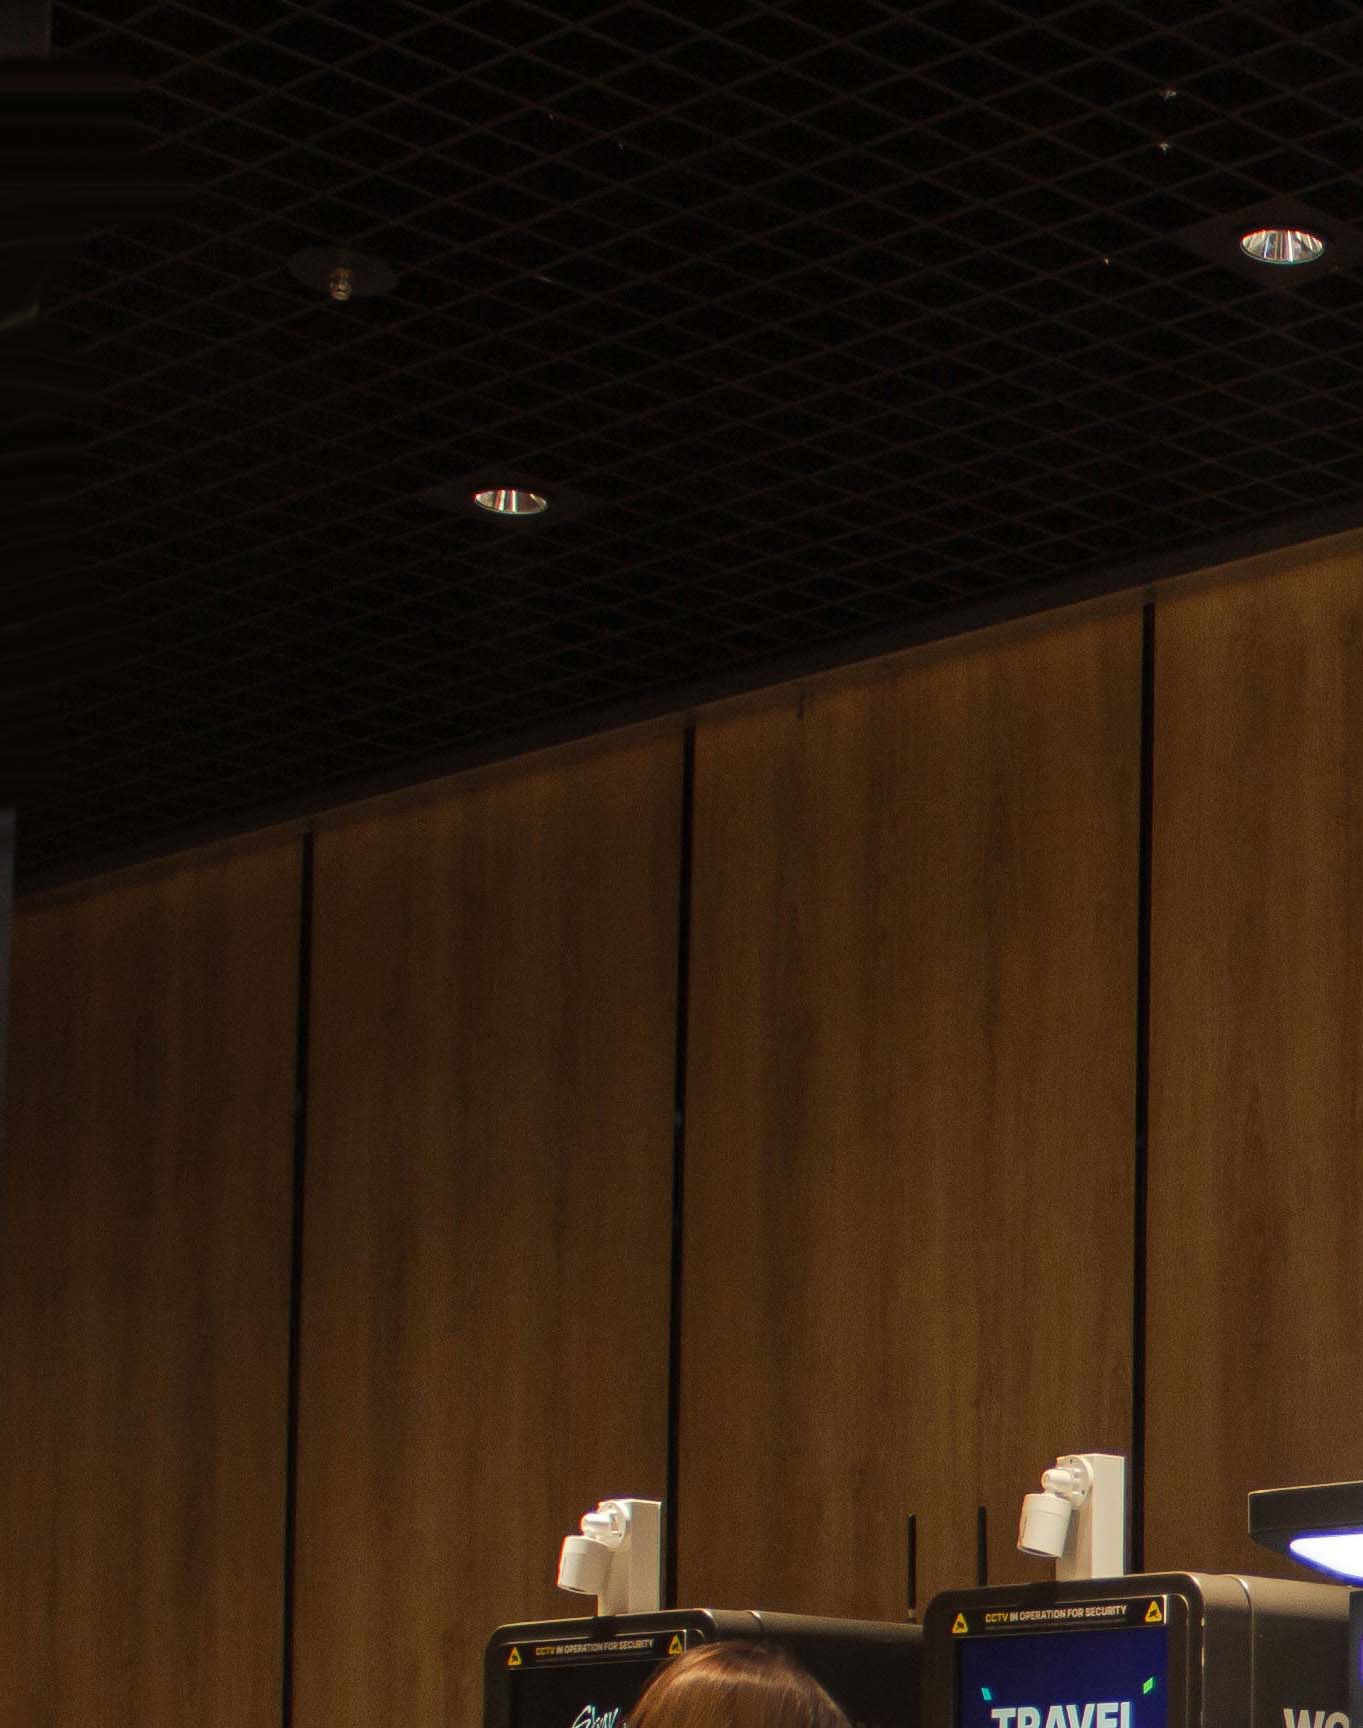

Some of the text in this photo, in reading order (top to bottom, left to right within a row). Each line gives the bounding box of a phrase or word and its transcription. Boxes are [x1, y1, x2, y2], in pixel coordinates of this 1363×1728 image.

[985, 1604, 1127, 1624] CCTV IN OPERATION FOR SECURITY
